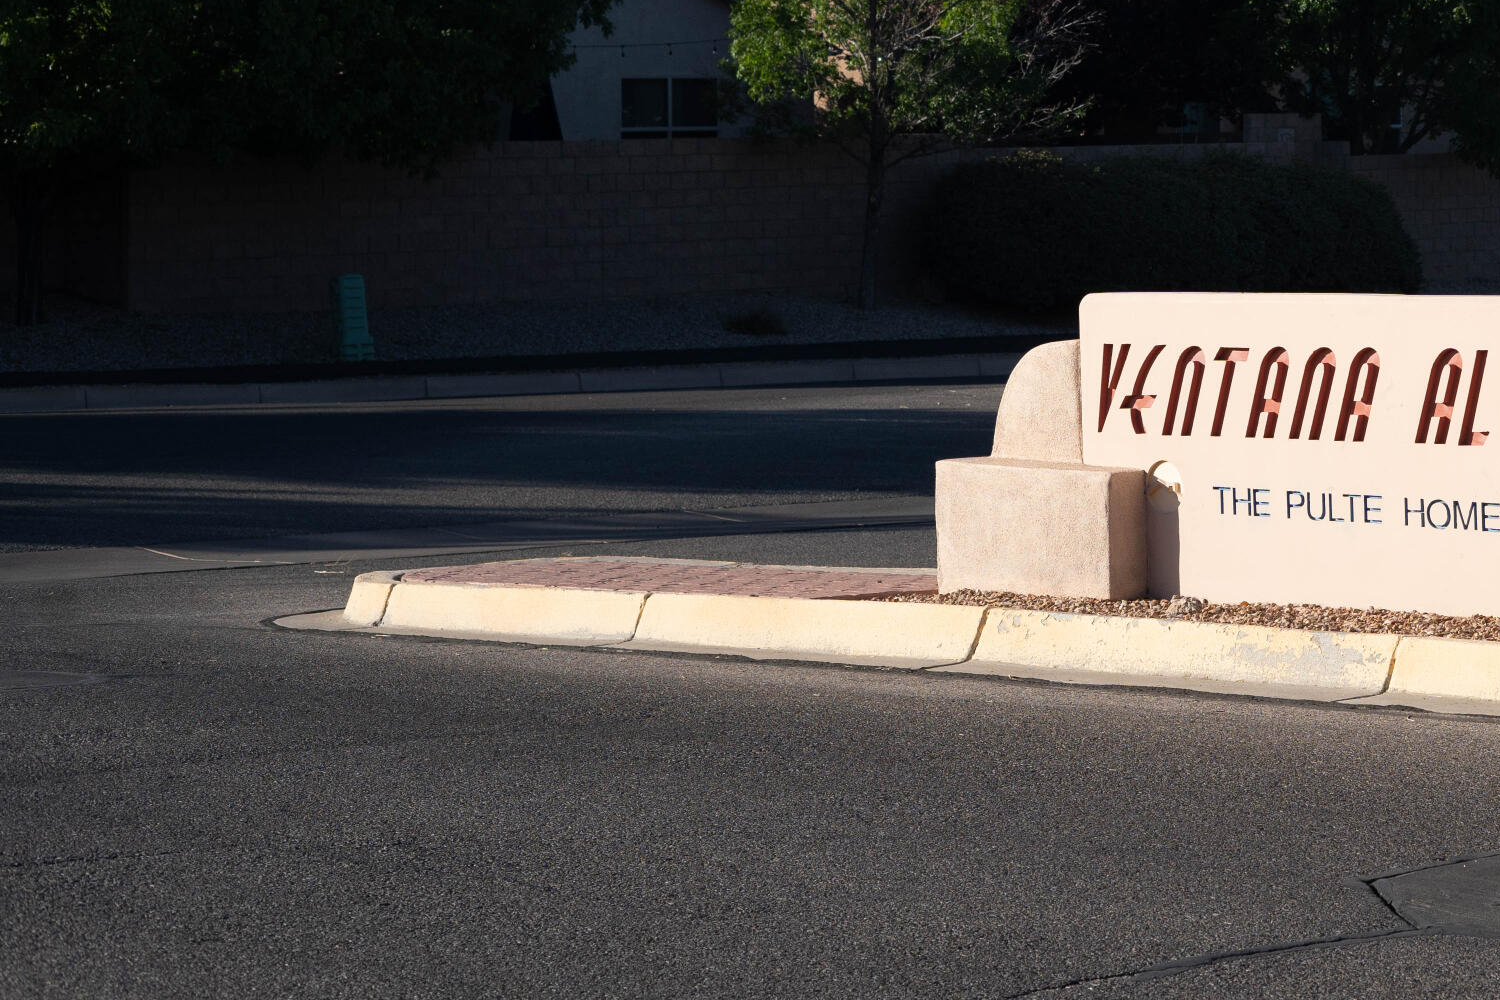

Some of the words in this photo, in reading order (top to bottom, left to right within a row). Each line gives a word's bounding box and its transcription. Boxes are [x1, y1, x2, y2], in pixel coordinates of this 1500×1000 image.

[1097, 343, 1381, 441] VENTANA
[1414, 347, 1491, 447] AL
[1212, 486, 1271, 517] THE
[1286, 490, 1383, 525] PULTE
